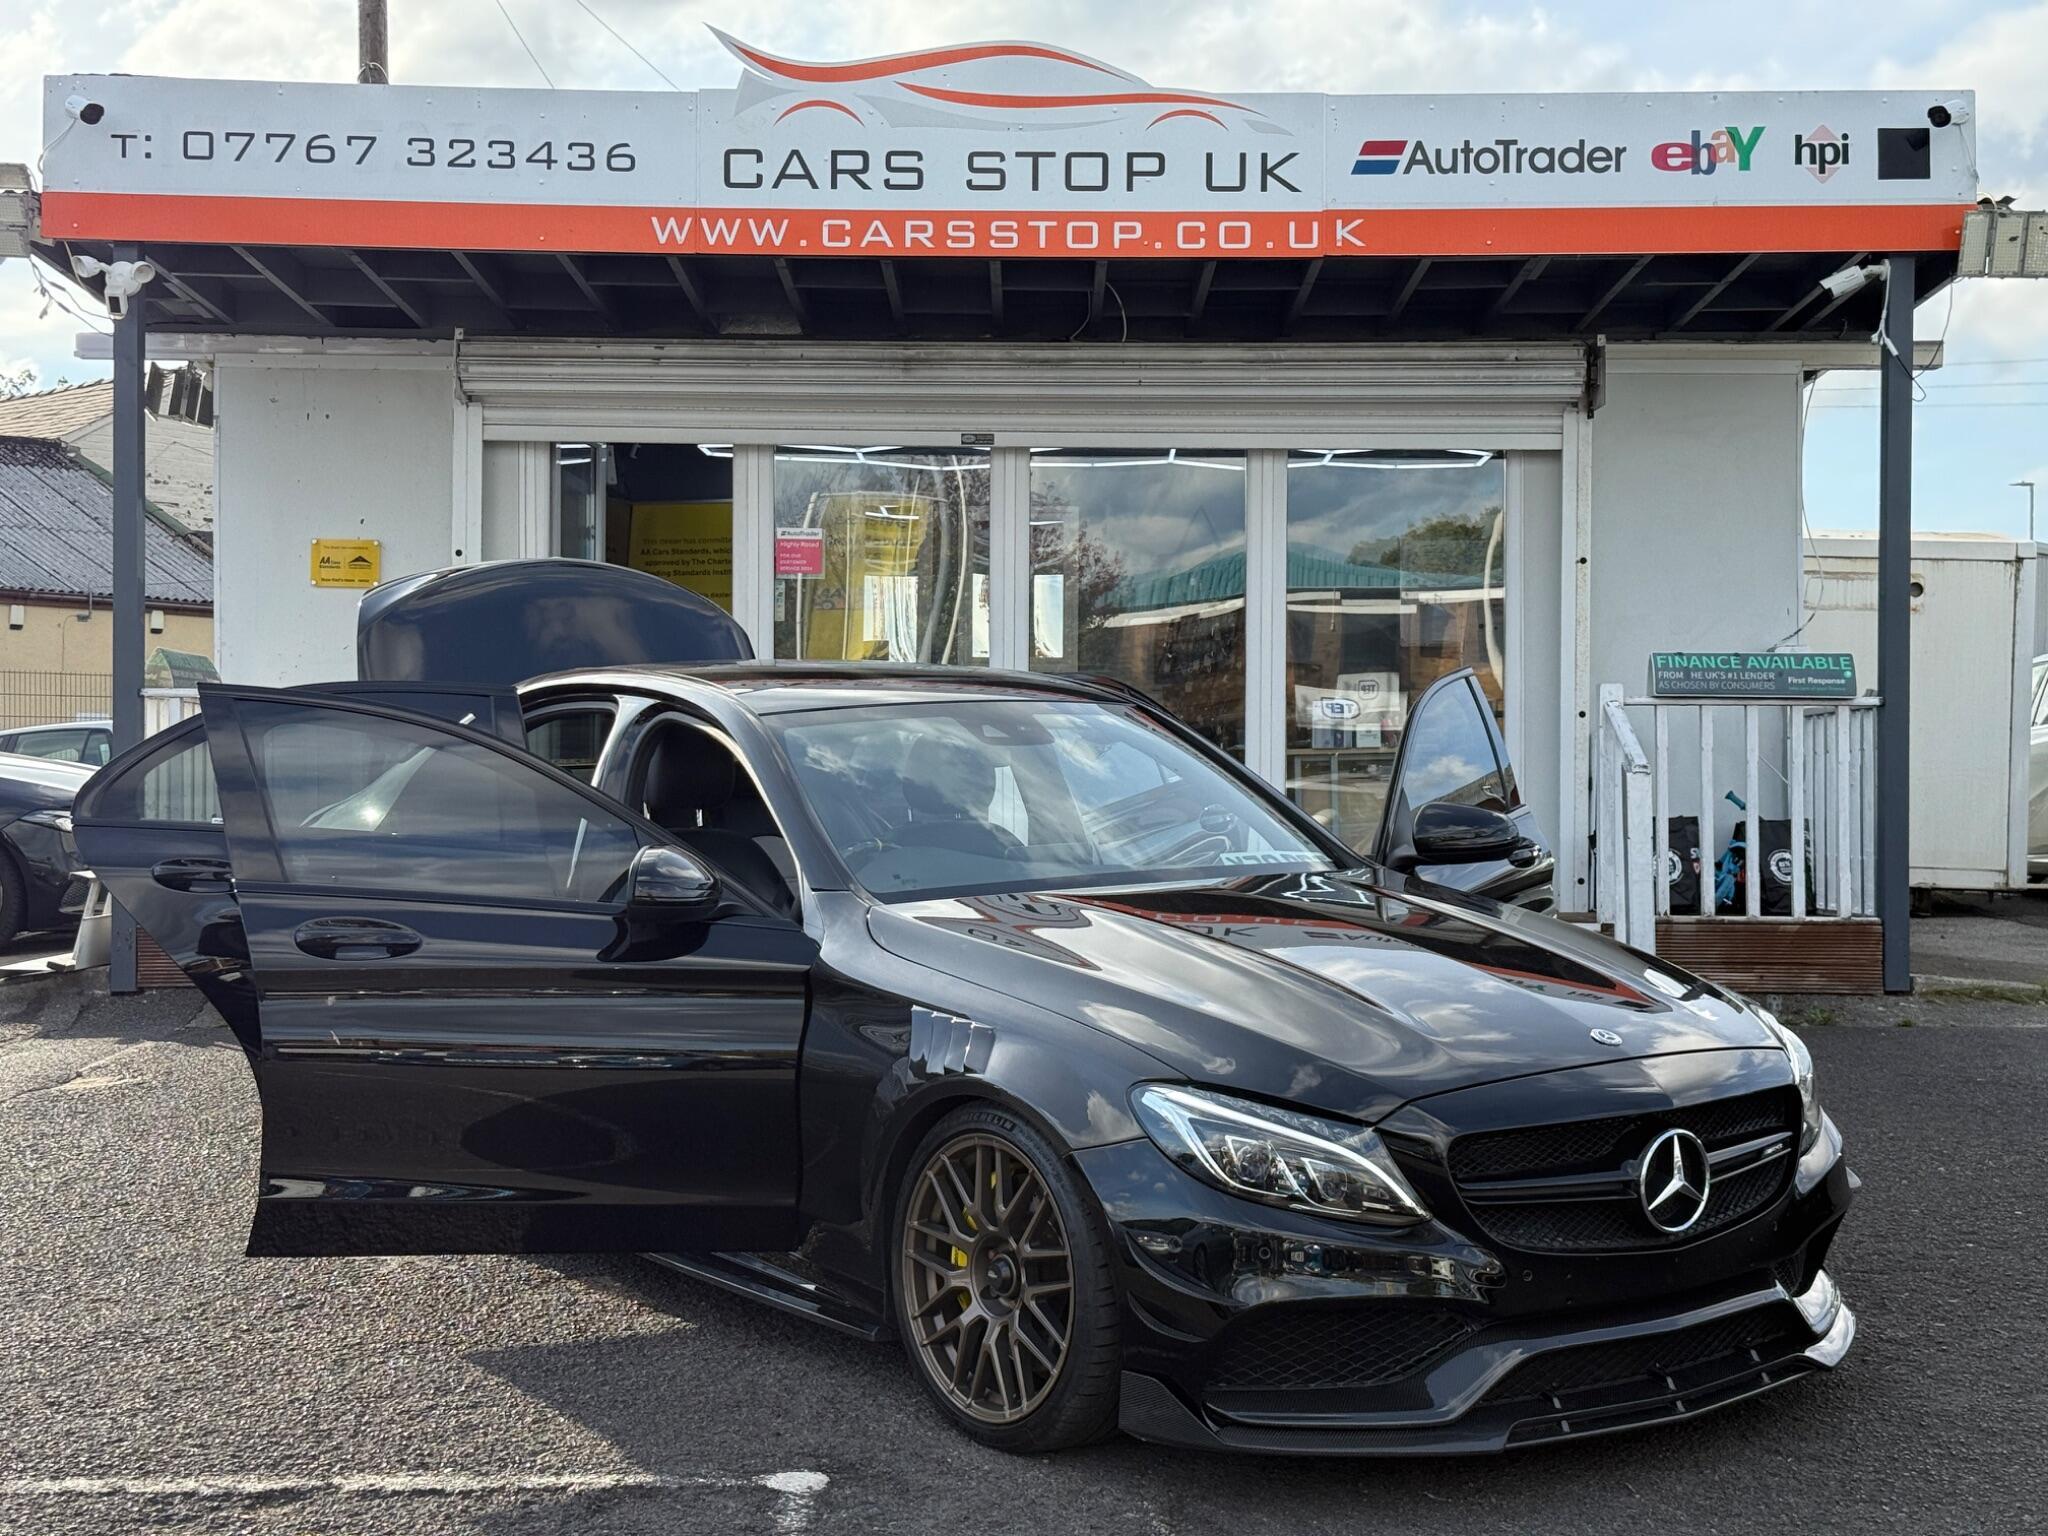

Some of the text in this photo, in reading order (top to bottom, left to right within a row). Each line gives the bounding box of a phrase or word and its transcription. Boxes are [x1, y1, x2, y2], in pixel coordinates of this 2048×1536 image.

[111, 131, 636, 172] T: 07767 323436
[1402, 139, 1627, 175] AutoTrader
[1795, 133, 1849, 174] hpi
[724, 149, 1301, 192] CARS STOP UK
[651, 216, 1365, 249] WWW.CARSSTOP.CO.UK
[1656, 656, 1853, 670] FINANCE AVAILABLE
[1740, 672, 1775, 680] LENDER
[1659, 681, 1775, 690] AS CHOSEN BY CONSUMERS
[1788, 676, 1846, 686] First Response
